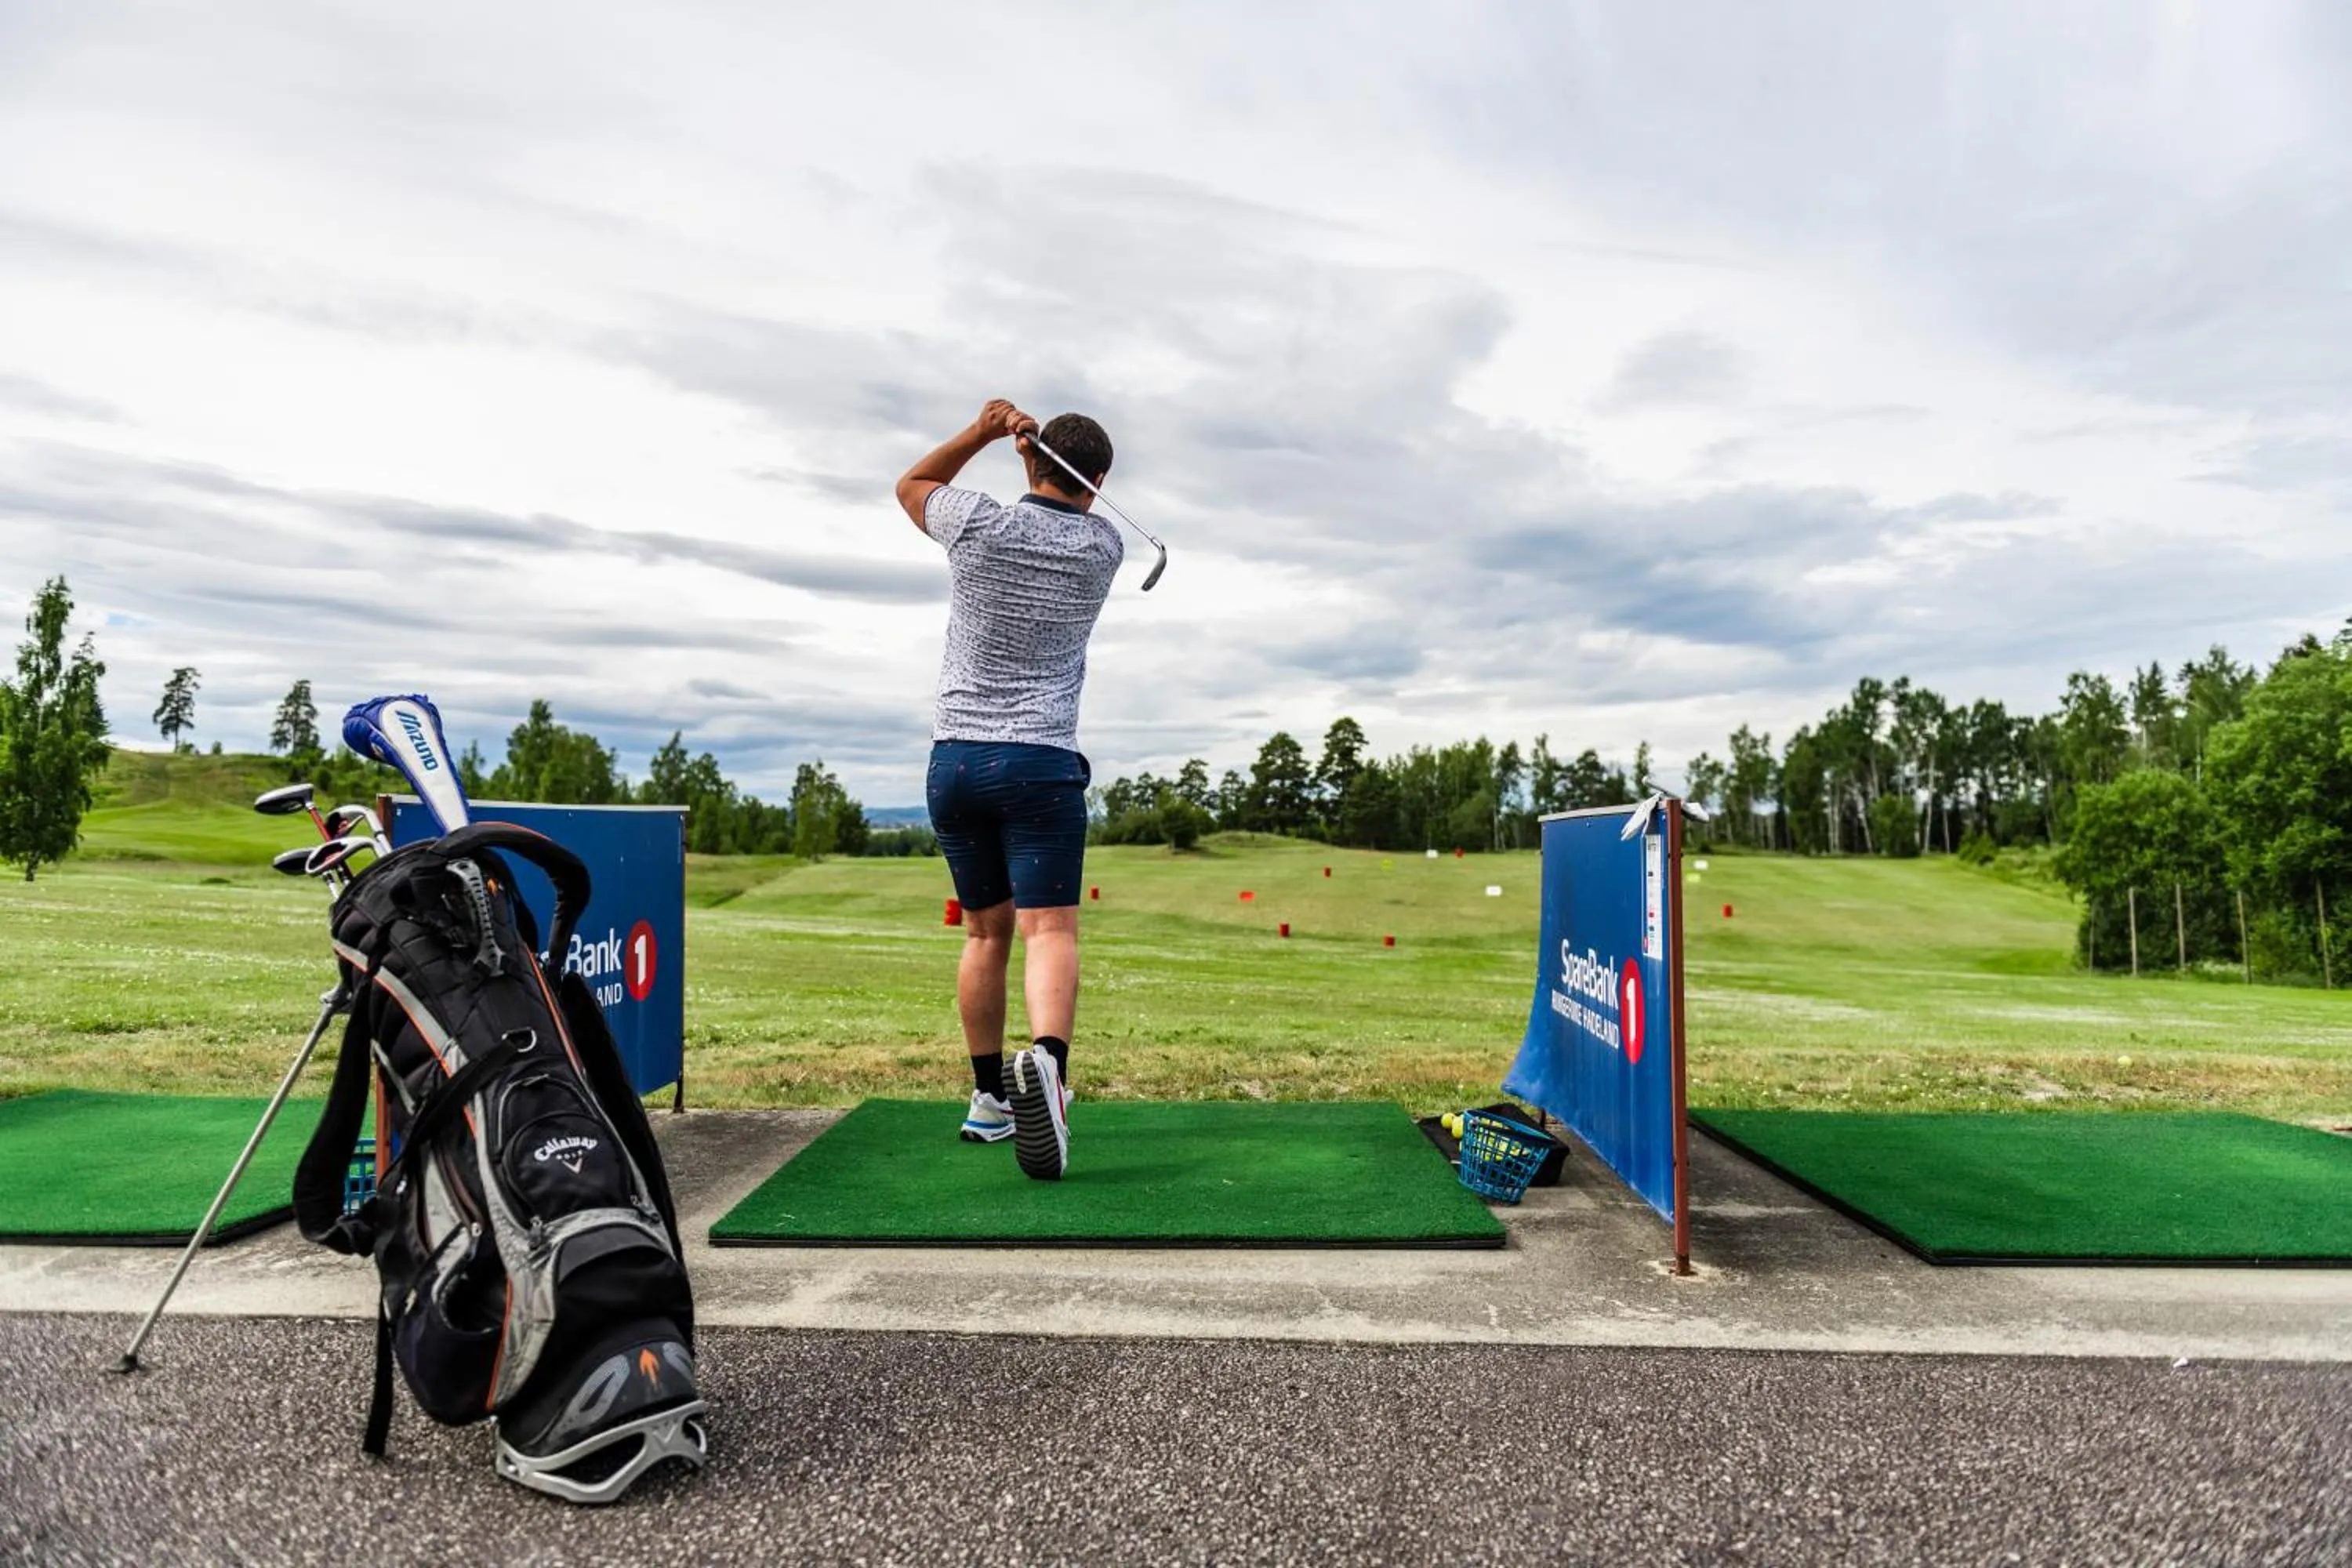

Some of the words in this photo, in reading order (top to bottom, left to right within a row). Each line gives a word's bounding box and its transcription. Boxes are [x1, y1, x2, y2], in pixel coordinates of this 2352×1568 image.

[394, 710, 439, 771] MIZUNO
[634, 934, 647, 986] 1
[1561, 938, 1619, 1011] SpareBank
[1625, 977, 1637, 1043] 1
[534, 1136, 598, 1162] Callaway
